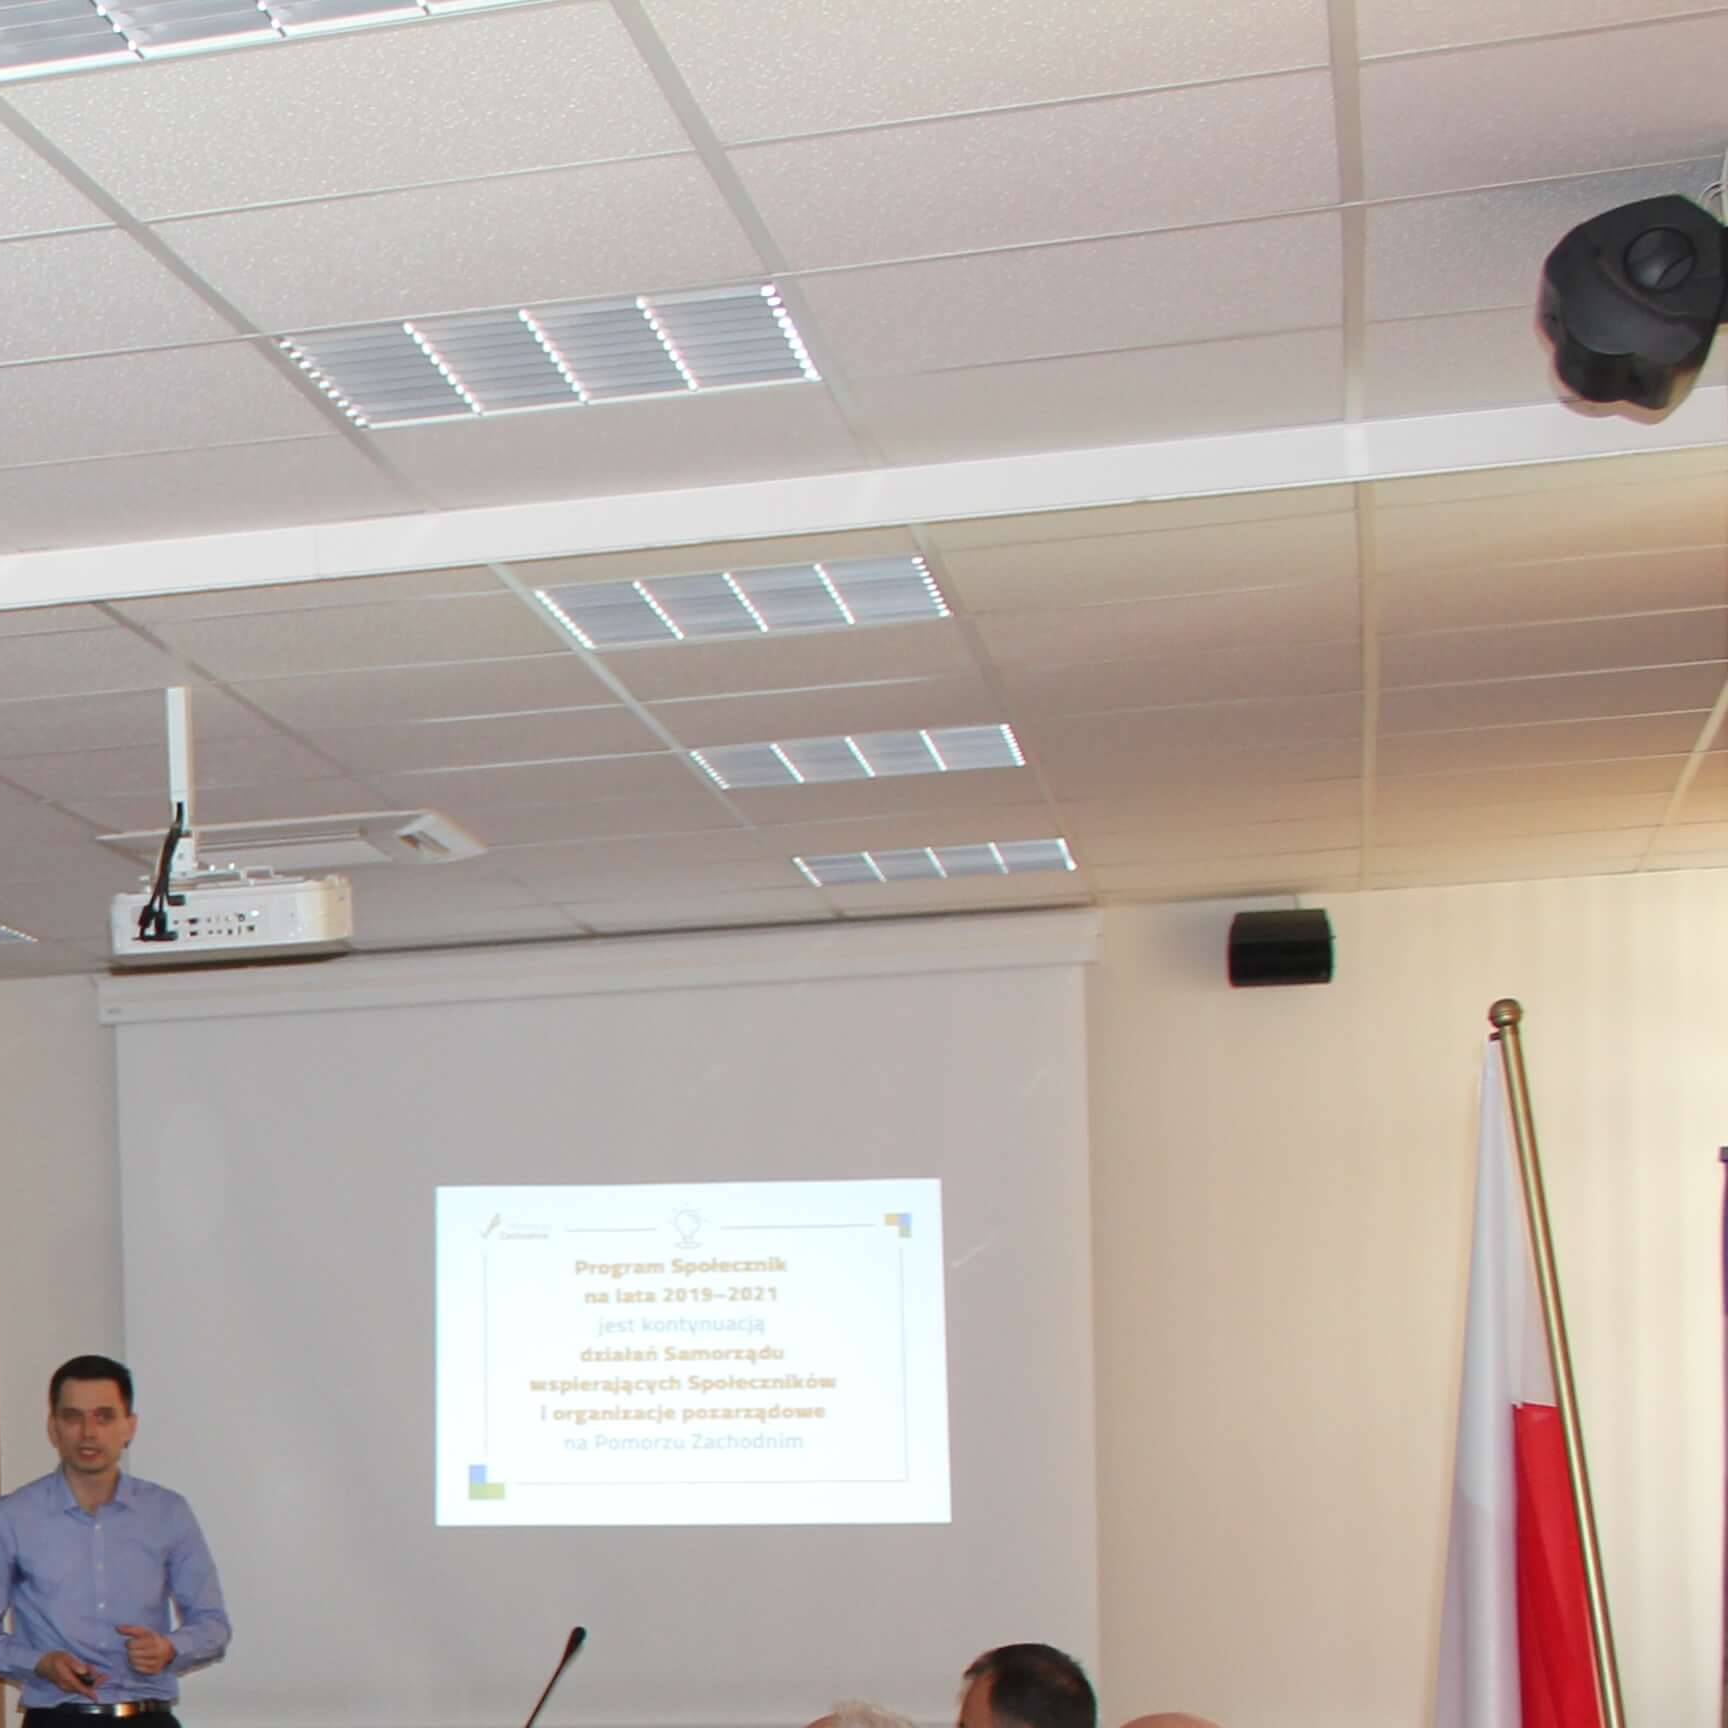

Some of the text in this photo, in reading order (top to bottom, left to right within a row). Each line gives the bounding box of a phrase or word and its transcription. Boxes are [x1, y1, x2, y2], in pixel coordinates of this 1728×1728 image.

[575, 1256, 787, 1280] Program Społecznik
[584, 1288, 610, 1305] na
[616, 1285, 656, 1304] lata
[598, 1314, 767, 1338] jest kontynuacją
[580, 1343, 785, 1364] działań Samorządu
[529, 1372, 837, 1396] wspierających Społeczników
[552, 1405, 676, 1426] organizacje
[682, 1402, 826, 1424] pozarządowe
[563, 1431, 805, 1452] na Pomorzu Zachodnim
